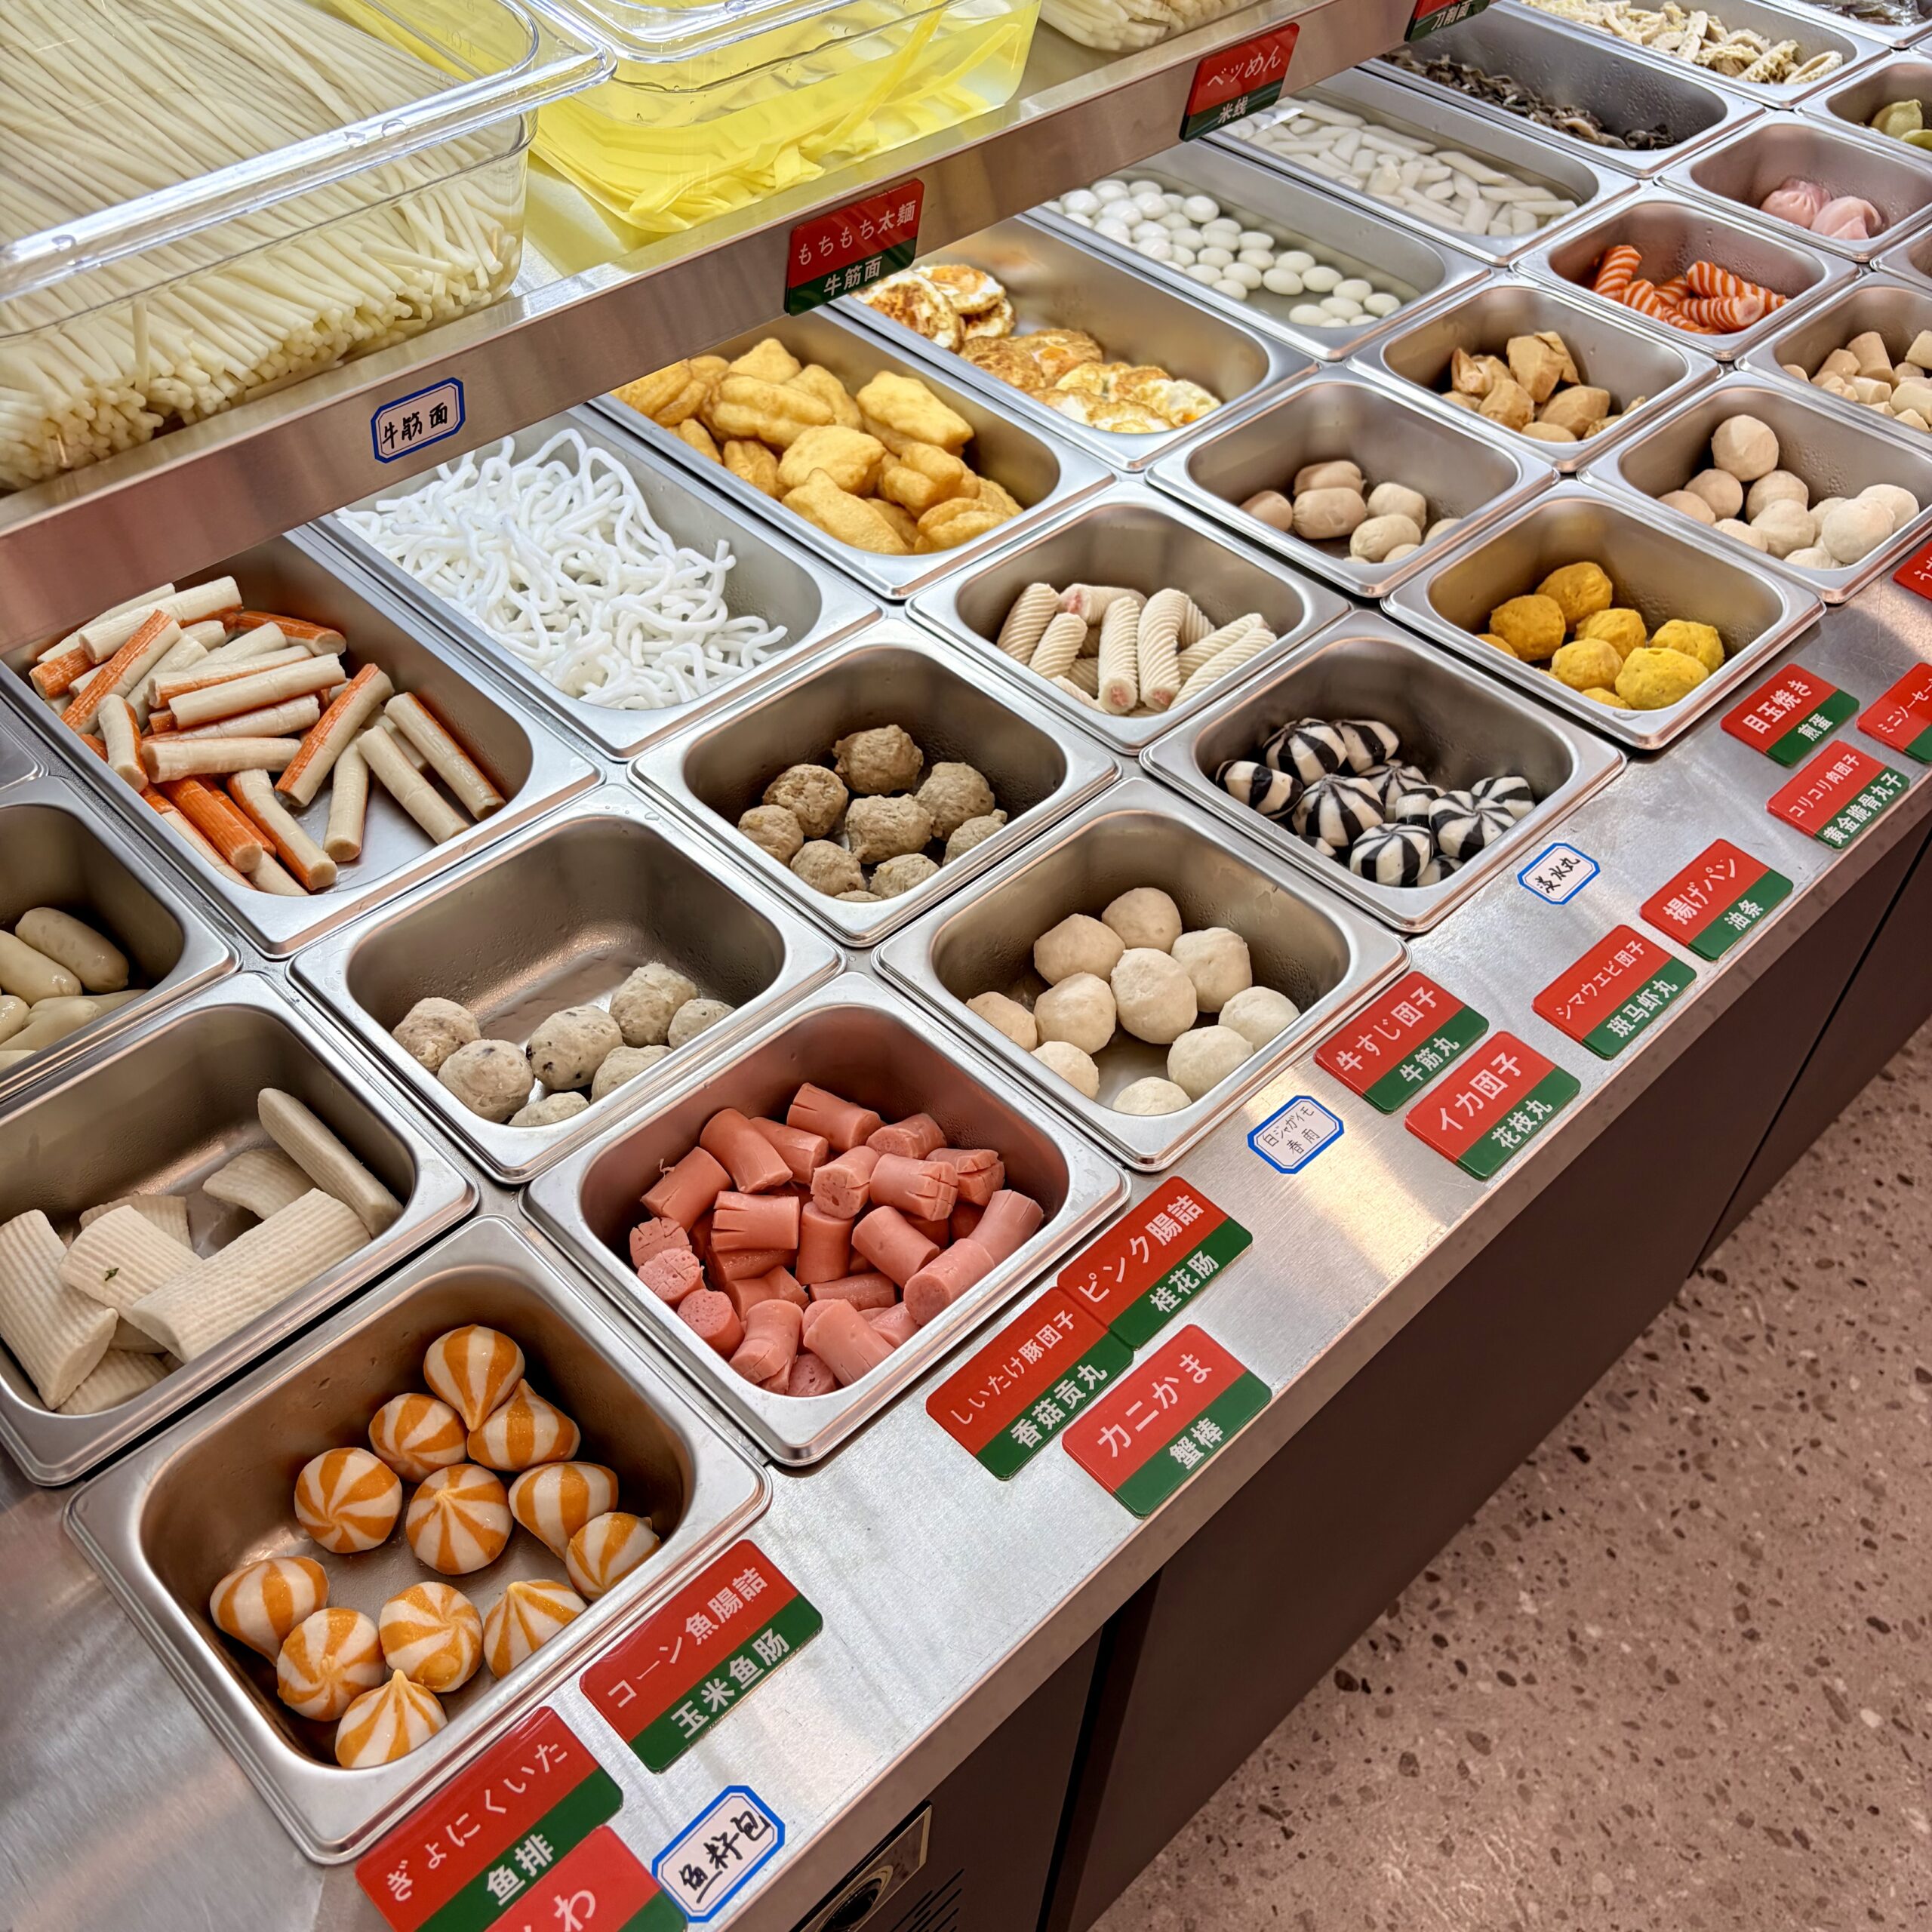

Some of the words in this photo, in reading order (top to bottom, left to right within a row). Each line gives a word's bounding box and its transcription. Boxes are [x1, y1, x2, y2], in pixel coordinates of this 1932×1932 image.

[1217, 96, 1248, 125] 米线
[823, 256, 883, 297] 牛筋面
[382, 402, 448, 449] 牛筋面
[1742, 680, 1811, 734] 目玉焼き
[1797, 713, 1833, 742] 煎蛋
[1878, 678, 1932, 734] ミニソーセー
[1789, 753, 1860, 817] コリコリ肉団子
[1823, 772, 1902, 844] 黄金脆骨丸子
[1663, 858, 1736, 924] 揚げパン
[1724, 900, 1764, 931] 油条
[1555, 940, 1644, 1019] シマウエビ団子
[1606, 980, 1678, 1038] 斑马虾丸
[1337, 986, 1437, 1073] 牛すじ団子
[1399, 1036, 1460, 1084] 牛筋丸
[1439, 1052, 1523, 1132] イカ団子
[1491, 1100, 1553, 1151] 花枝丸
[1078, 1195, 1204, 1303] ピンク腸詰
[1149, 1250, 1219, 1313] 桂花肠
[950, 1310, 1075, 1425] しいたけ豚団子
[1011, 1361, 1108, 1448] 香菇贡丸
[1097, 1353, 1213, 1457] カニかま
[1169, 1418, 1224, 1470] 蟹棒
[608, 1567, 768, 1708] コーン魚腸詰
[671, 1628, 791, 1739] 玉米鱼肠
[387, 1743, 568, 1902] ぎょにくいた
[487, 1833, 555, 1906] 鱼排
[523, 1890, 596, 1932] わ
